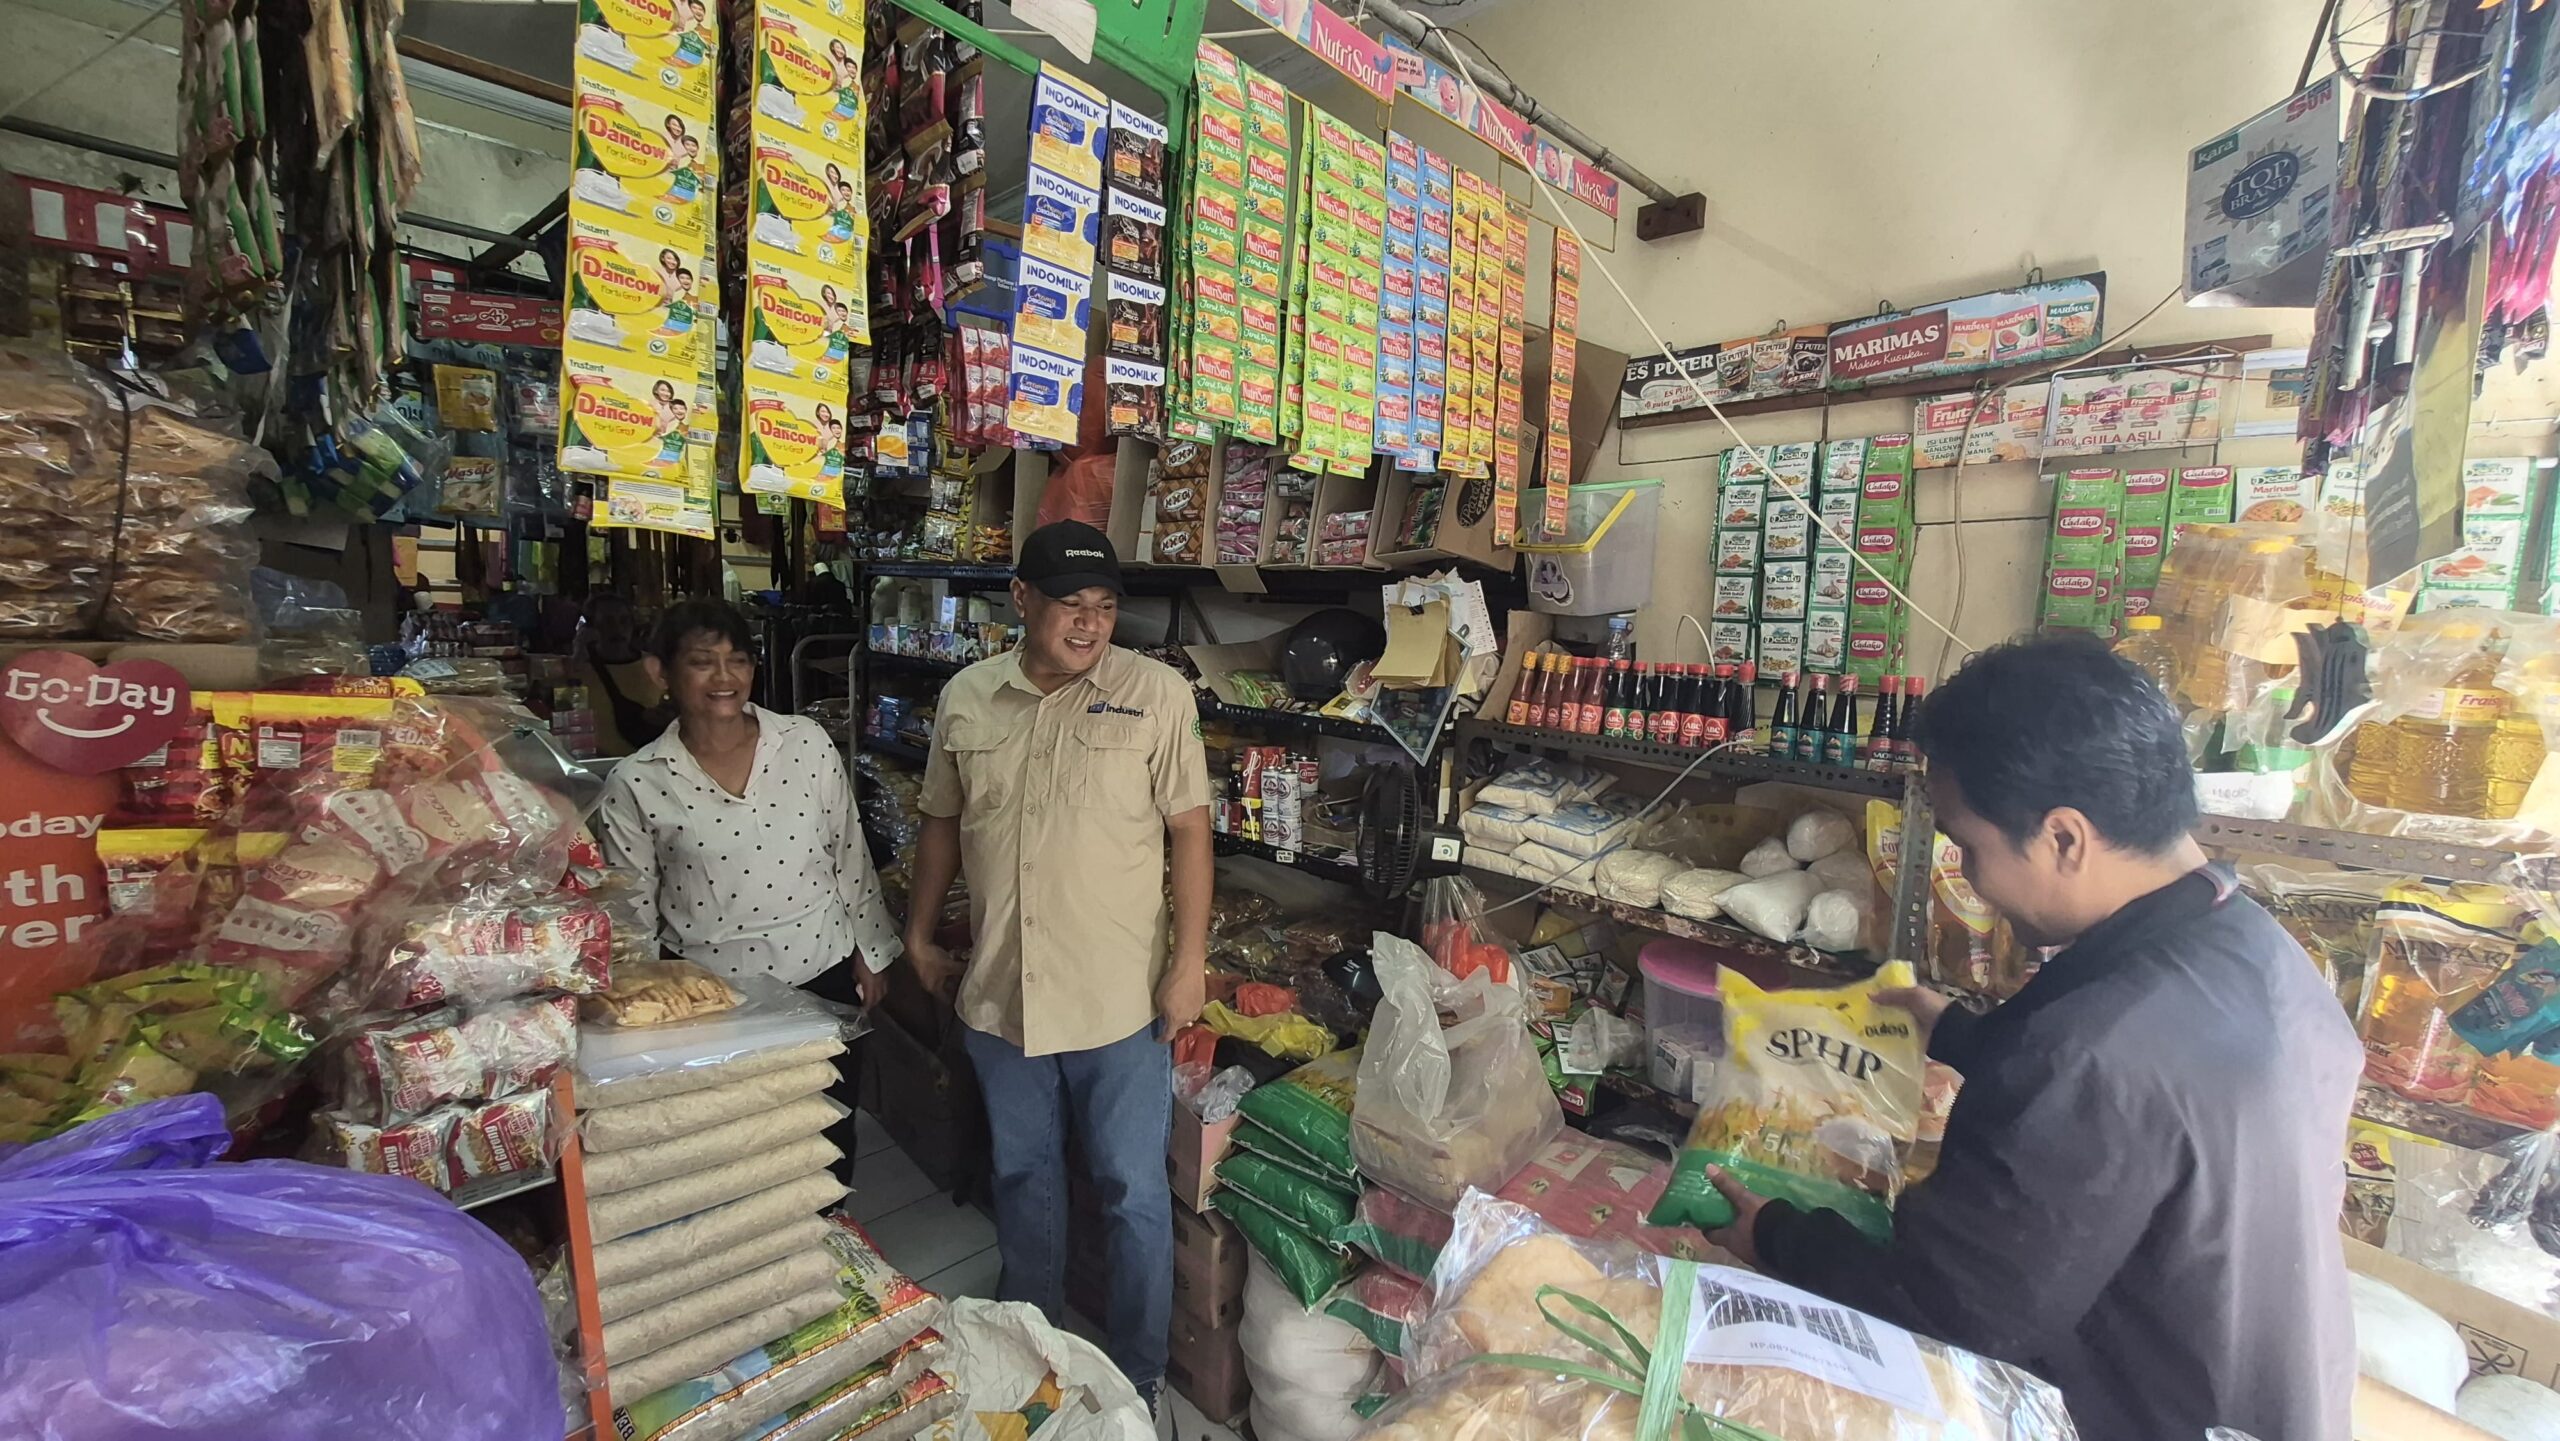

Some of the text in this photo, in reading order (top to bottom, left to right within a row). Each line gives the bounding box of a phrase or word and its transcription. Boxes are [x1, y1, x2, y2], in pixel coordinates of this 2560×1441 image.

[770, 35, 833, 82] Dancow
[1314, 20, 1386, 93] NutriSari
[581, 77, 617, 96] Instant
[1045, 85, 1101, 121] INDOMILK
[2285, 88, 2332, 123] SUN
[1116, 107, 1165, 139] INDOMILK
[588, 114, 667, 160] Dancow
[2197, 140, 2235, 164] kara
[766, 165, 828, 204] Dancow
[2230, 158, 2291, 198] TOP
[1035, 174, 1092, 207] INDOMILK
[1575, 172, 1615, 211] NutriSari
[2230, 174, 2292, 211] BRAND
[1113, 194, 1162, 222] INDOMILK
[576, 219, 610, 237] Instant
[583, 255, 661, 296] Dancow
[1026, 265, 1083, 293] INDOMILK
[1113, 279, 1161, 301] INDOMILK
[763, 292, 824, 328] Dancow
[1996, 310, 2035, 328] MARIMAS
[2049, 301, 2091, 315] MARIMAS
[1954, 320, 1991, 332] MARIMAS
[1834, 324, 1942, 364] MARIMAS
[570, 359, 605, 374] Instant
[1019, 352, 1076, 378] INDOMILK
[1111, 363, 1158, 382] INDOMILK
[1626, 353, 1715, 382] ES PUTER
[1847, 356, 1882, 373] Makin
[577, 392, 655, 428] Dancow
[759, 416, 818, 446] Dancow
[2081, 430, 2162, 446] GULA ASLI
[2127, 474, 2163, 485] adaku
[2185, 469, 2225, 479] Ladaku
[2250, 473, 2300, 485] Desaku
[2061, 516, 2099, 529] Ladaku
[2126, 536, 2156, 546] daku
[1065, 549, 1105, 559] Reebok
[2054, 576, 2090, 589] Ladaku
[4, 668, 176, 716] Go-Day
[1105, 703, 1145, 718] industri
[1606, 715, 1623, 724] ABC
[1628, 715, 1644, 725] ABC
[1660, 718, 1677, 729] ABC
[1684, 721, 1702, 732] ABC
[1706, 725, 1721, 735] ABC
[1765, 1026, 1883, 1081] SPHP
[485, 1124, 506, 1162] Goreng
